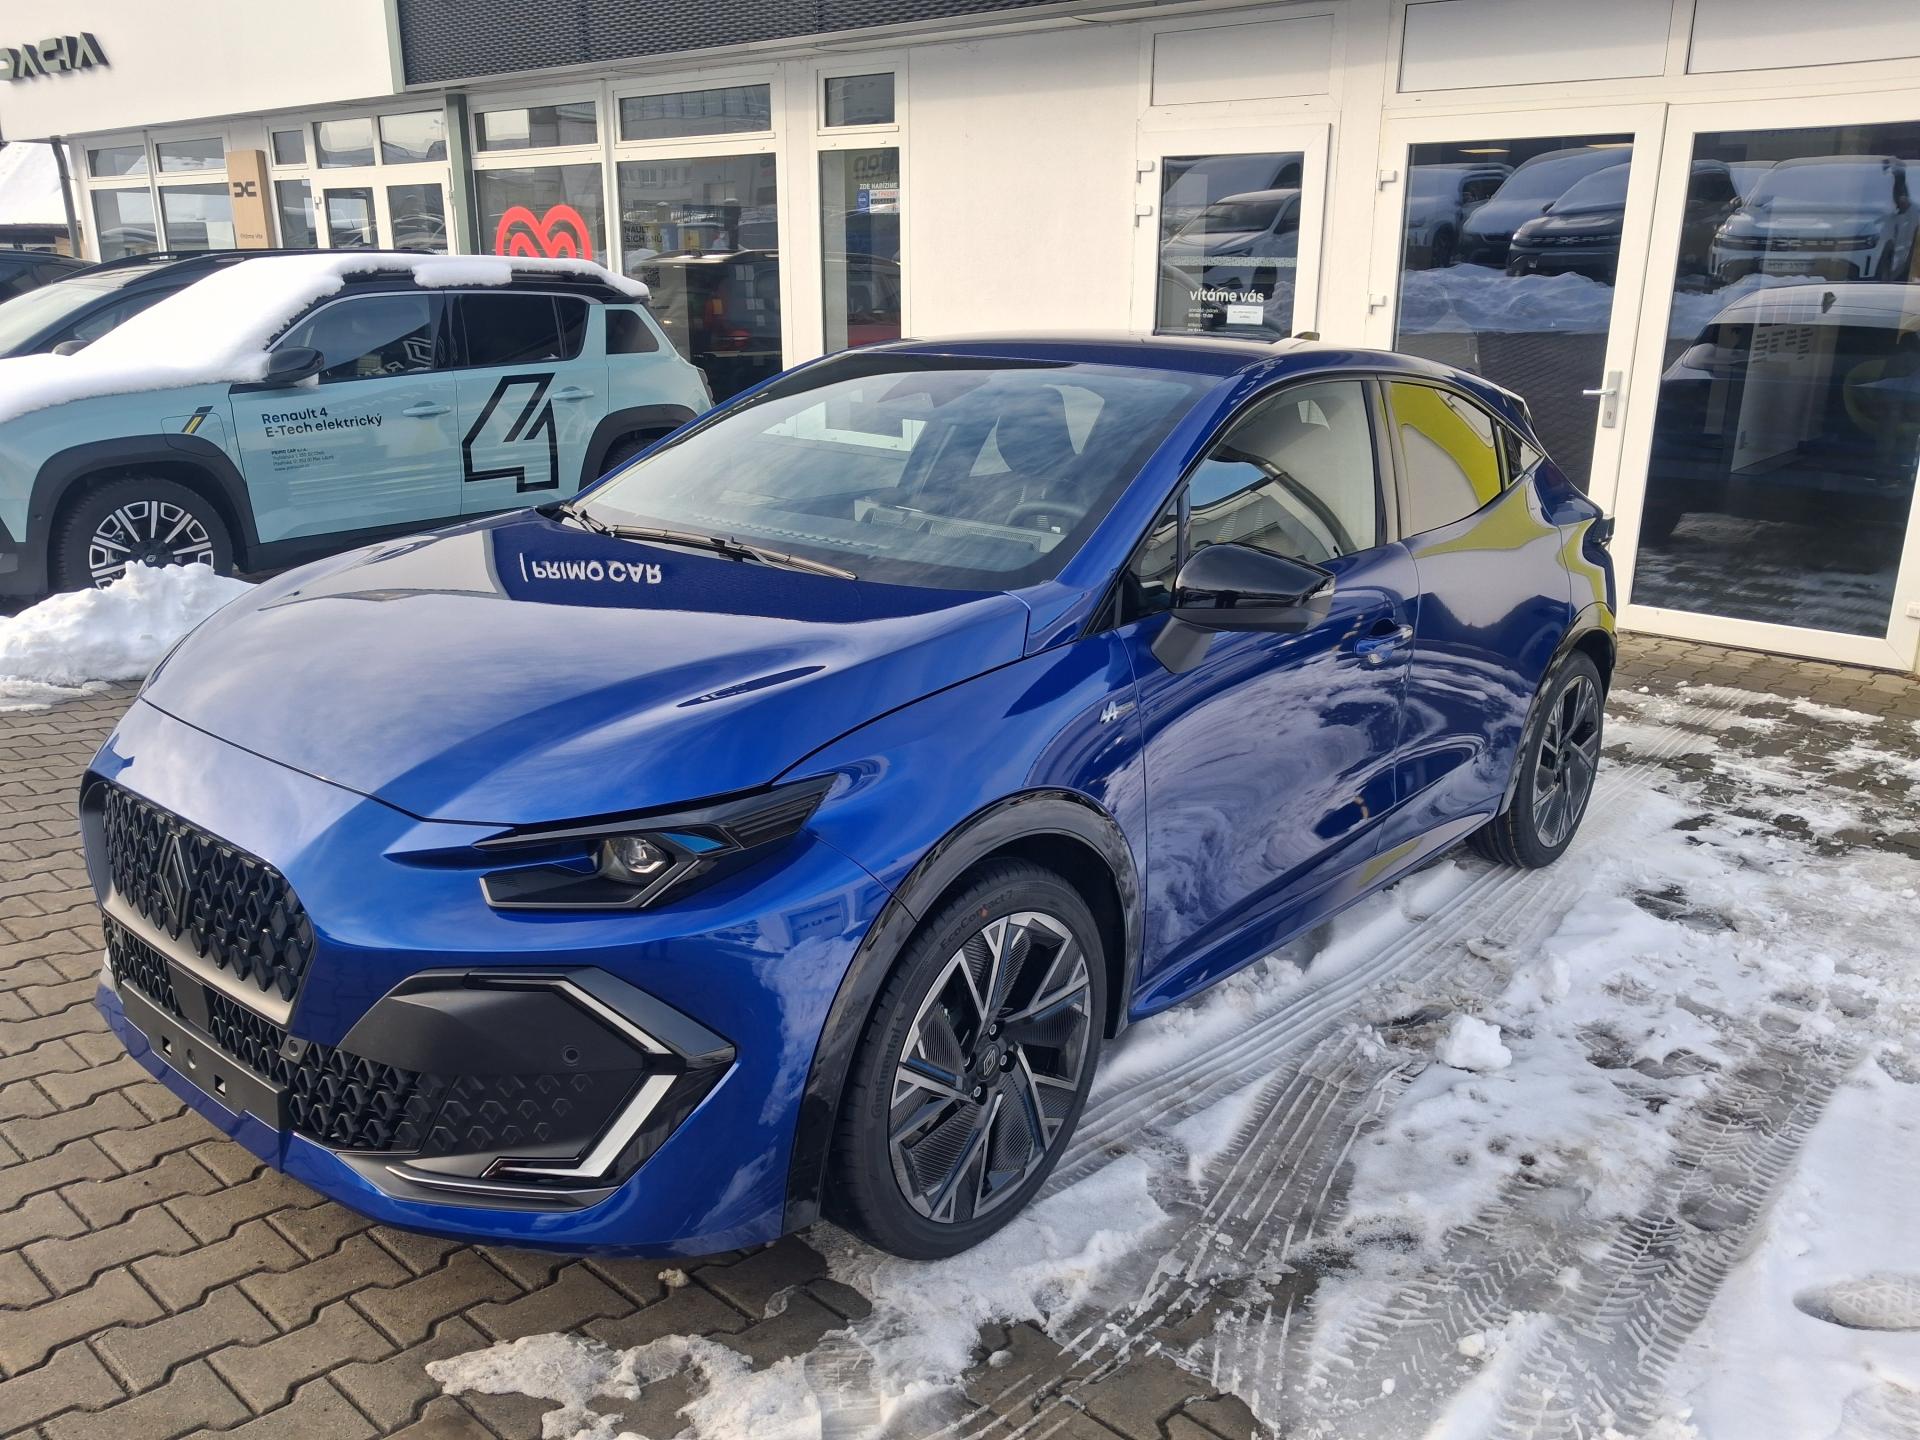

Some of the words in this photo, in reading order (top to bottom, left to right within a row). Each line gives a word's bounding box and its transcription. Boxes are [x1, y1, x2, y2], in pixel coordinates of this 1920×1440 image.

[0, 31, 110, 81] DACIA
[1189, 287, 1237, 302] vítáme
[1239, 289, 1264, 303] vás
[261, 408, 317, 425] Renault
[319, 407, 328, 418] 4
[265, 421, 313, 438] E-Tech
[315, 412, 382, 432] elektrický
